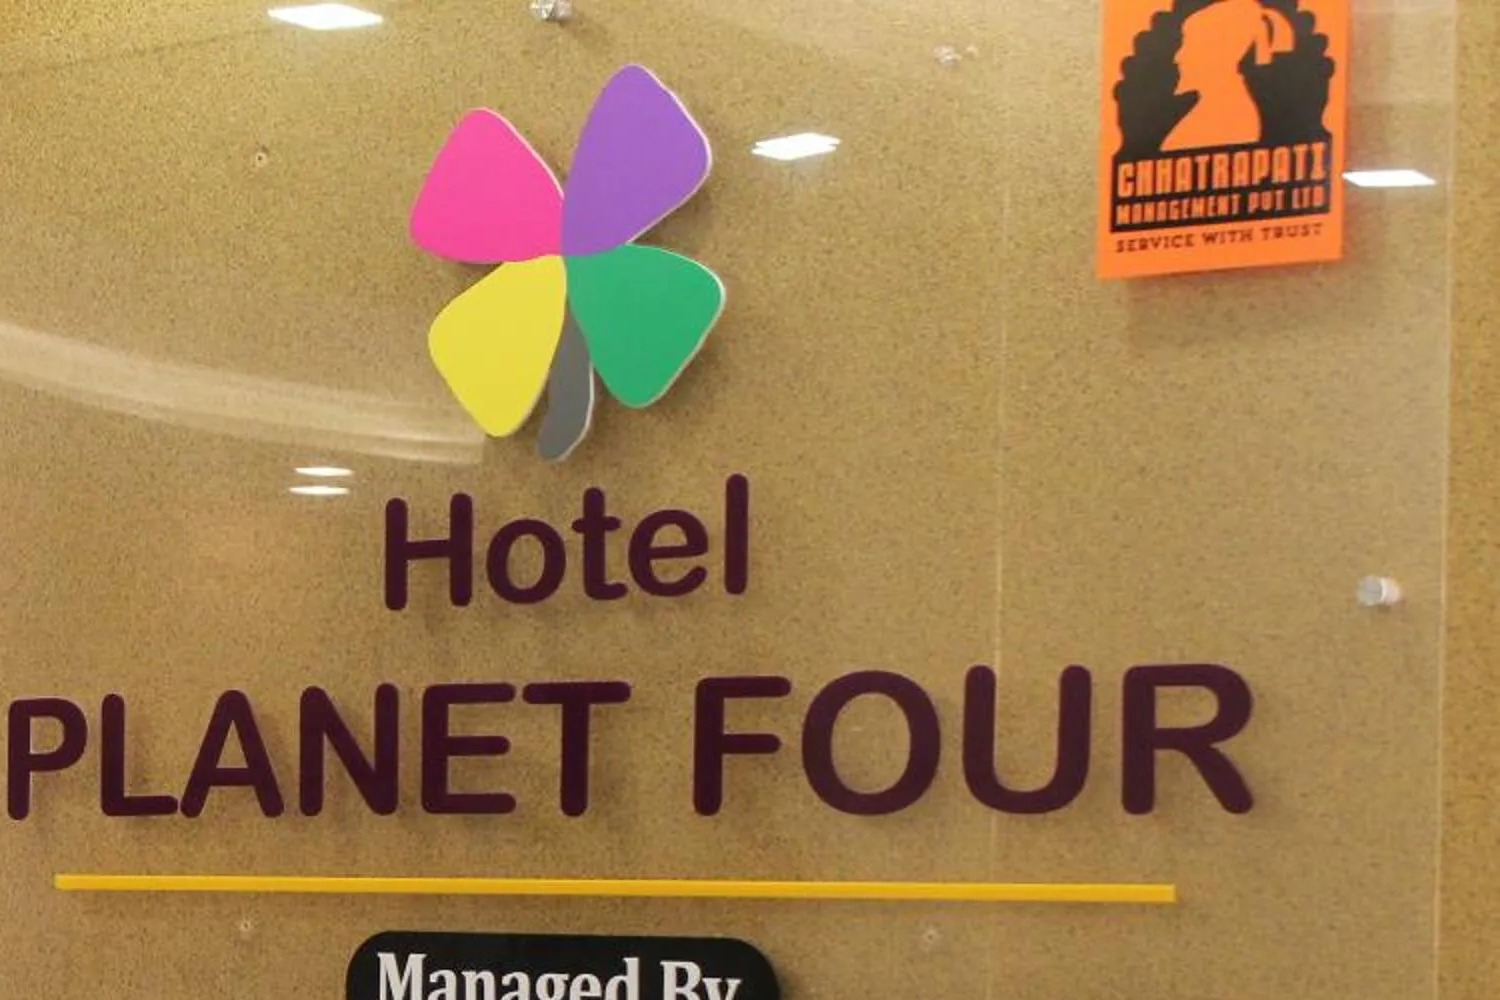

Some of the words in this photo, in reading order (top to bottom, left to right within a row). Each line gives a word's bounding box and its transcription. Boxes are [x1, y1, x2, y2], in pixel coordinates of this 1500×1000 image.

[1117, 142, 1326, 198] CHHATRAPATI
[1116, 194, 1241, 225] MANAGEMENT
[1292, 186, 1325, 209] LTD
[1116, 231, 1195, 253] SERVICE
[1201, 228, 1254, 246] WITH
[1261, 222, 1323, 239] TRUST
[385, 473, 749, 611] Hotel
[7, 681, 631, 820] PLANET
[693, 663, 1254, 816] FOUR
